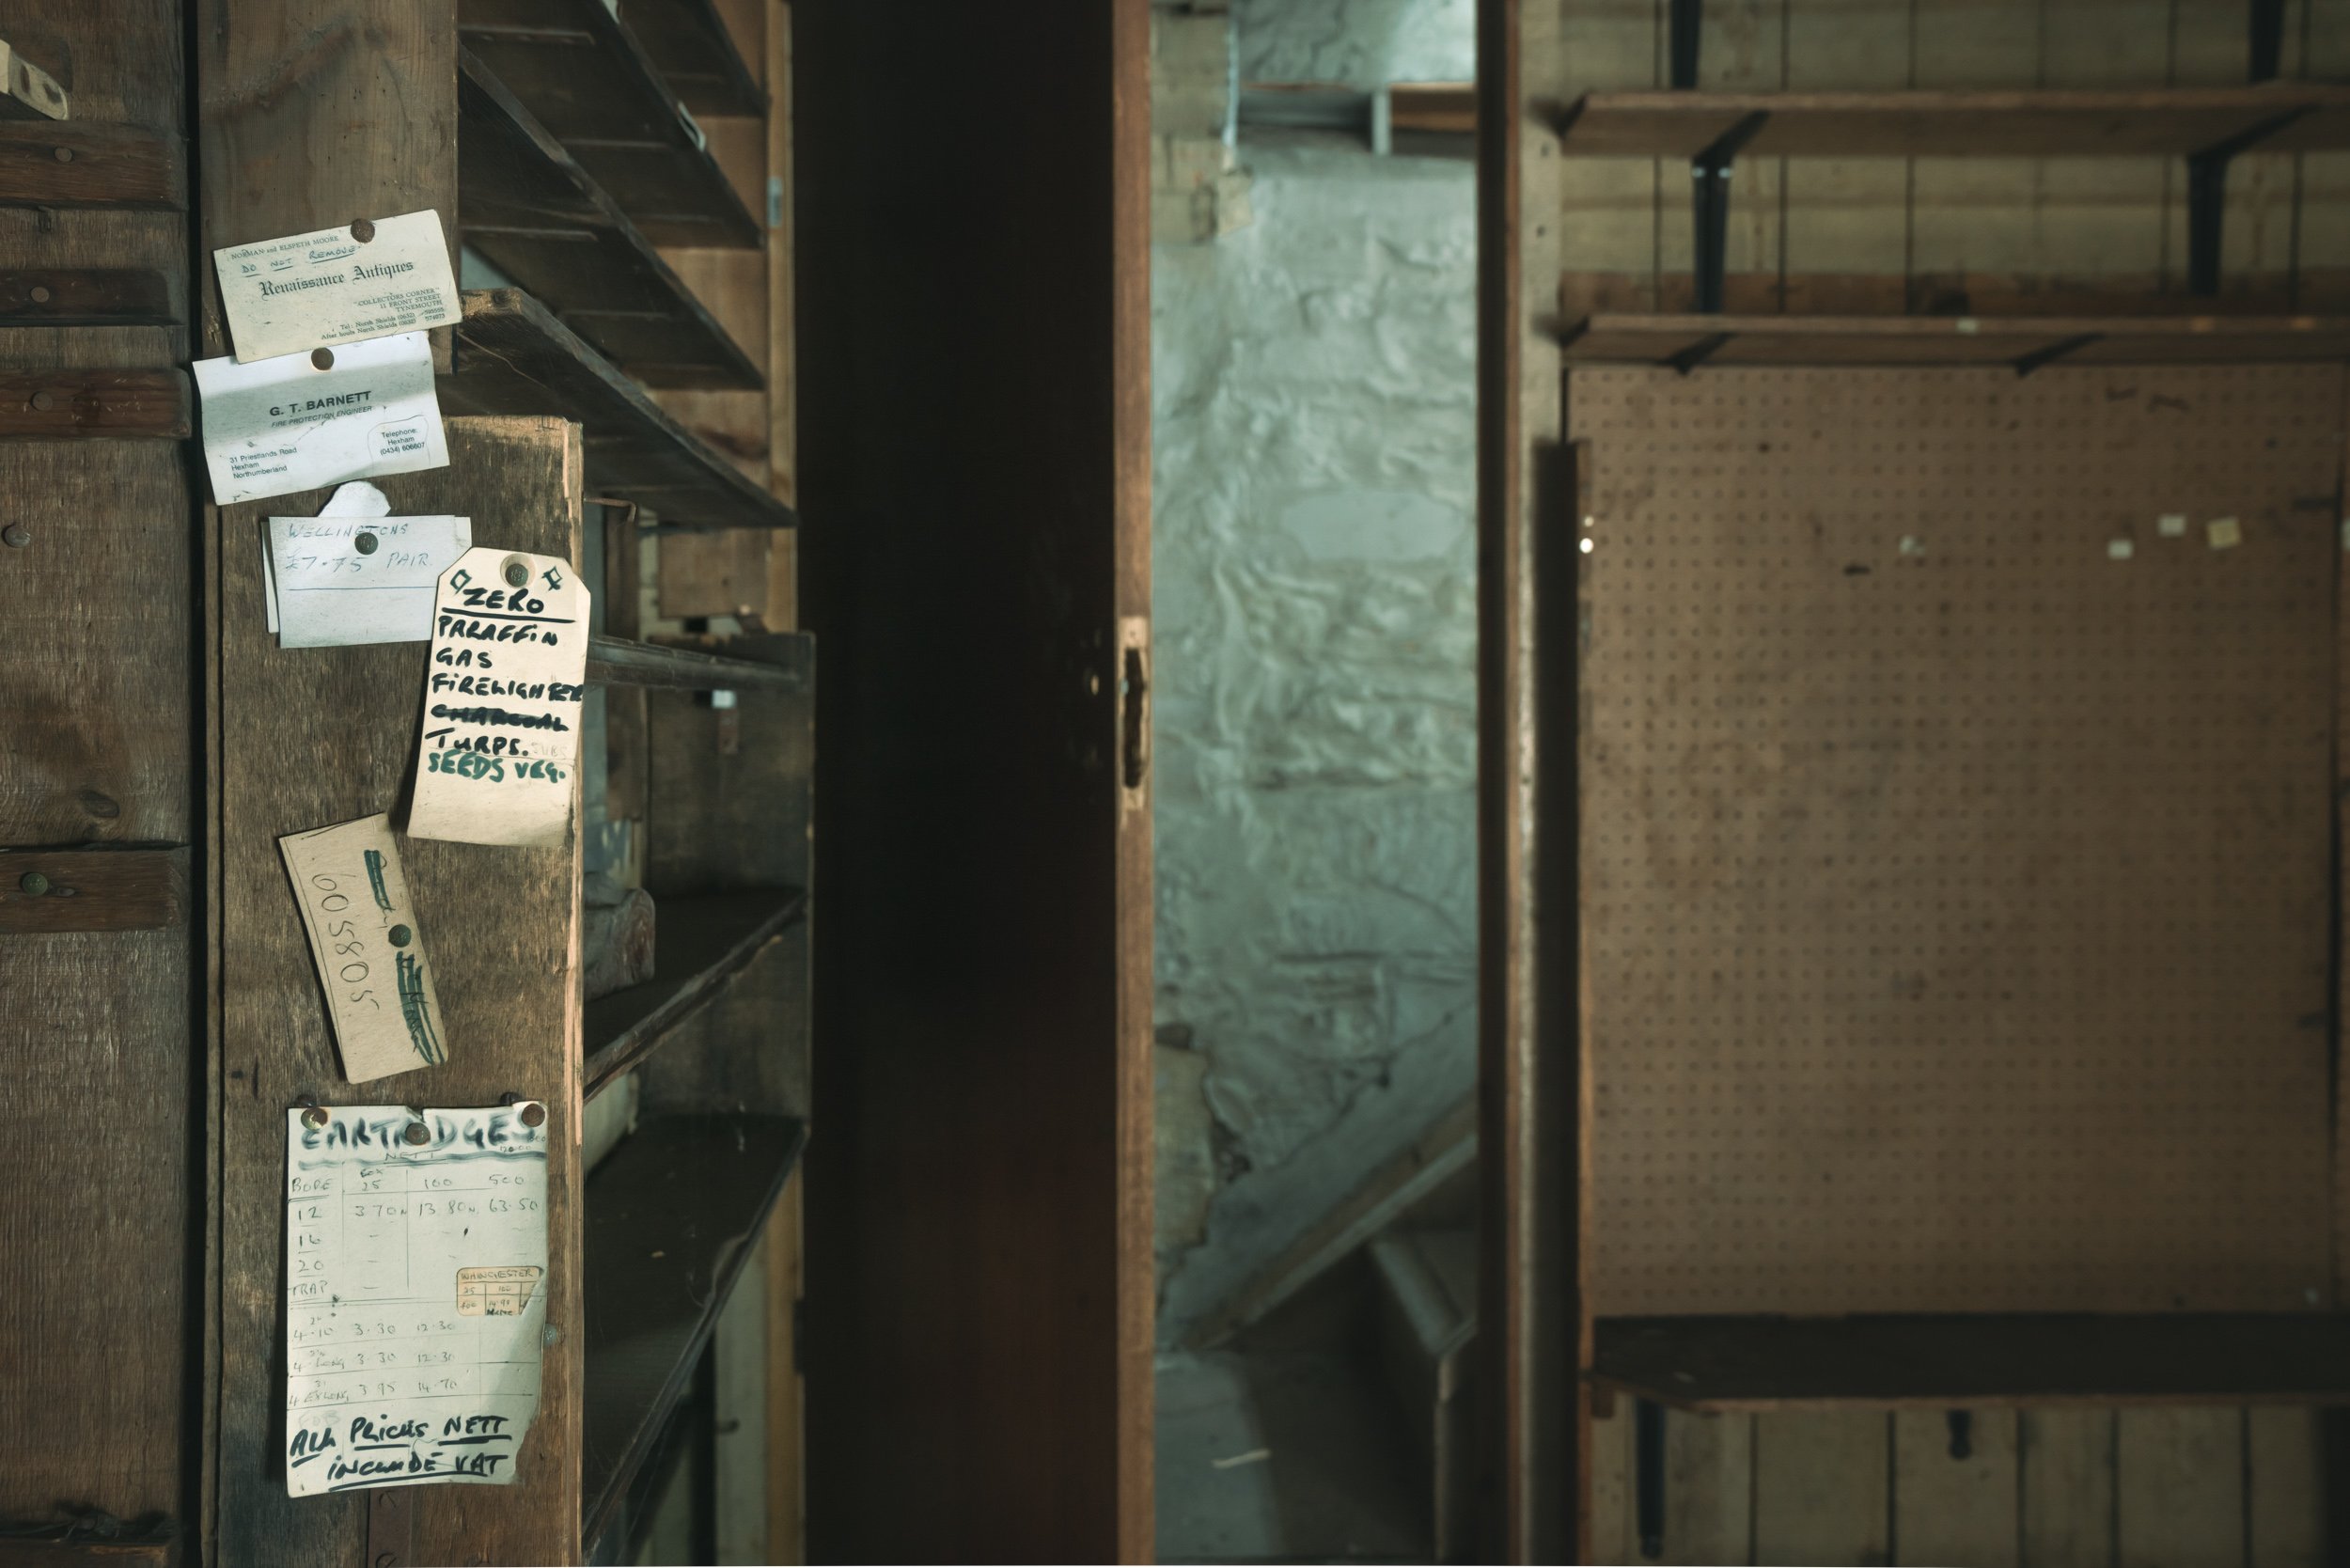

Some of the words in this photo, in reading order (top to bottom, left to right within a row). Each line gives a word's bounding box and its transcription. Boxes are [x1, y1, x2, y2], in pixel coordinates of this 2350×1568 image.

[231, 248, 264, 259] NORMAN
[279, 241, 310, 251] ELSPETH
[313, 235, 339, 245] MOORE
[242, 263, 257, 274] DO
[271, 258, 292, 268] NOT
[308, 245, 357, 259] REMOVE
[258, 274, 345, 301] Renaissance
[352, 260, 414, 282] Antiques
[389, 298, 414, 308] FRONT
[415, 293, 441, 303] STREET
[396, 299, 443, 312] TYNEMOUTH
[375, 316, 396, 324] Shields
[377, 322, 398, 331] Shields
[269, 406, 284, 416] G.
[289, 403, 302, 414] T.
[306, 390, 372, 411] BARNETT
[272, 420, 288, 429] FIRE
[289, 413, 335, 426] PROTECTION
[337, 405, 372, 418] ENGINEER
[382, 428, 418, 440] Telephone:
[387, 435, 415, 447] Hexham
[240, 450, 277, 463] Priestlands
[279, 447, 297, 456] Road
[380, 447, 400, 457] (0434)
[231, 461, 259, 471] Hexham
[233, 464, 288, 480] Northumberland
[387, 552, 431, 569] PAIR
[462, 588, 545, 614] ZERO
[435, 647, 494, 668] GAS
[428, 748, 505, 783] SEEDS
[312, 873, 380, 1010] 605805
[291, 1177, 335, 1192] BORE
[362, 1179, 382, 1192] 25
[424, 1178, 452, 1189] 100
[489, 1173, 525, 1185] 500
[298, 1206, 322, 1221] 12
[298, 1233, 321, 1247] 16
[298, 1260, 324, 1273] 20
[288, 1279, 328, 1296] TRAP
[290, 1427, 337, 1457] ALL
[443, 1415, 509, 1436] NETT
[455, 1454, 509, 1476] VAT
